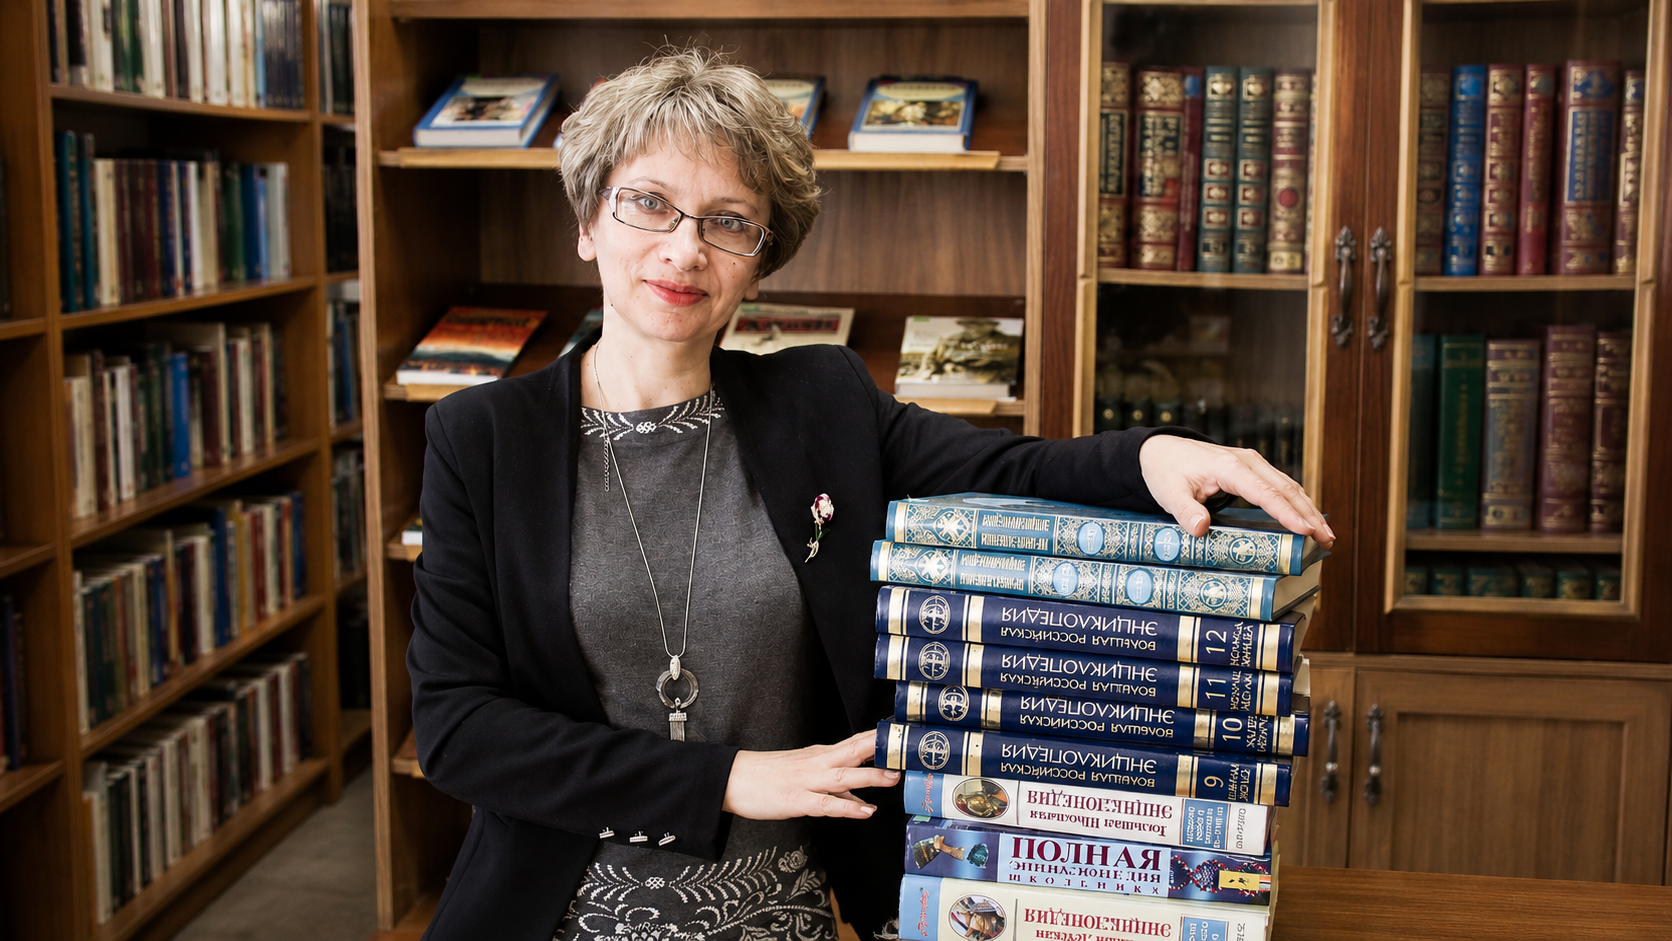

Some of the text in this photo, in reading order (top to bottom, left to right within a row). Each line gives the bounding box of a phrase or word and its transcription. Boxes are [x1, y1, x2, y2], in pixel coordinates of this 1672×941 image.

[1002, 607, 1158, 636] ЭНЦИКЛОПЕДИЯ
[1206, 629, 1228, 655] 12
[1002, 653, 1158, 682] ЭНЦИКЛОПЕДИЯ
[1205, 677, 1227, 700] 11
[1020, 697, 1176, 725] ЭНЦИКЛОПЕДИЯ
[1020, 715, 1105, 733] РОССИЙСКАЯ
[1222, 717, 1243, 742] 10
[1001, 744, 1157, 773] ЭНЦИКЛОПЕДИЯ
[1204, 776, 1224, 788] 9
[1012, 837, 1161, 871] ПОЛНАЯ
